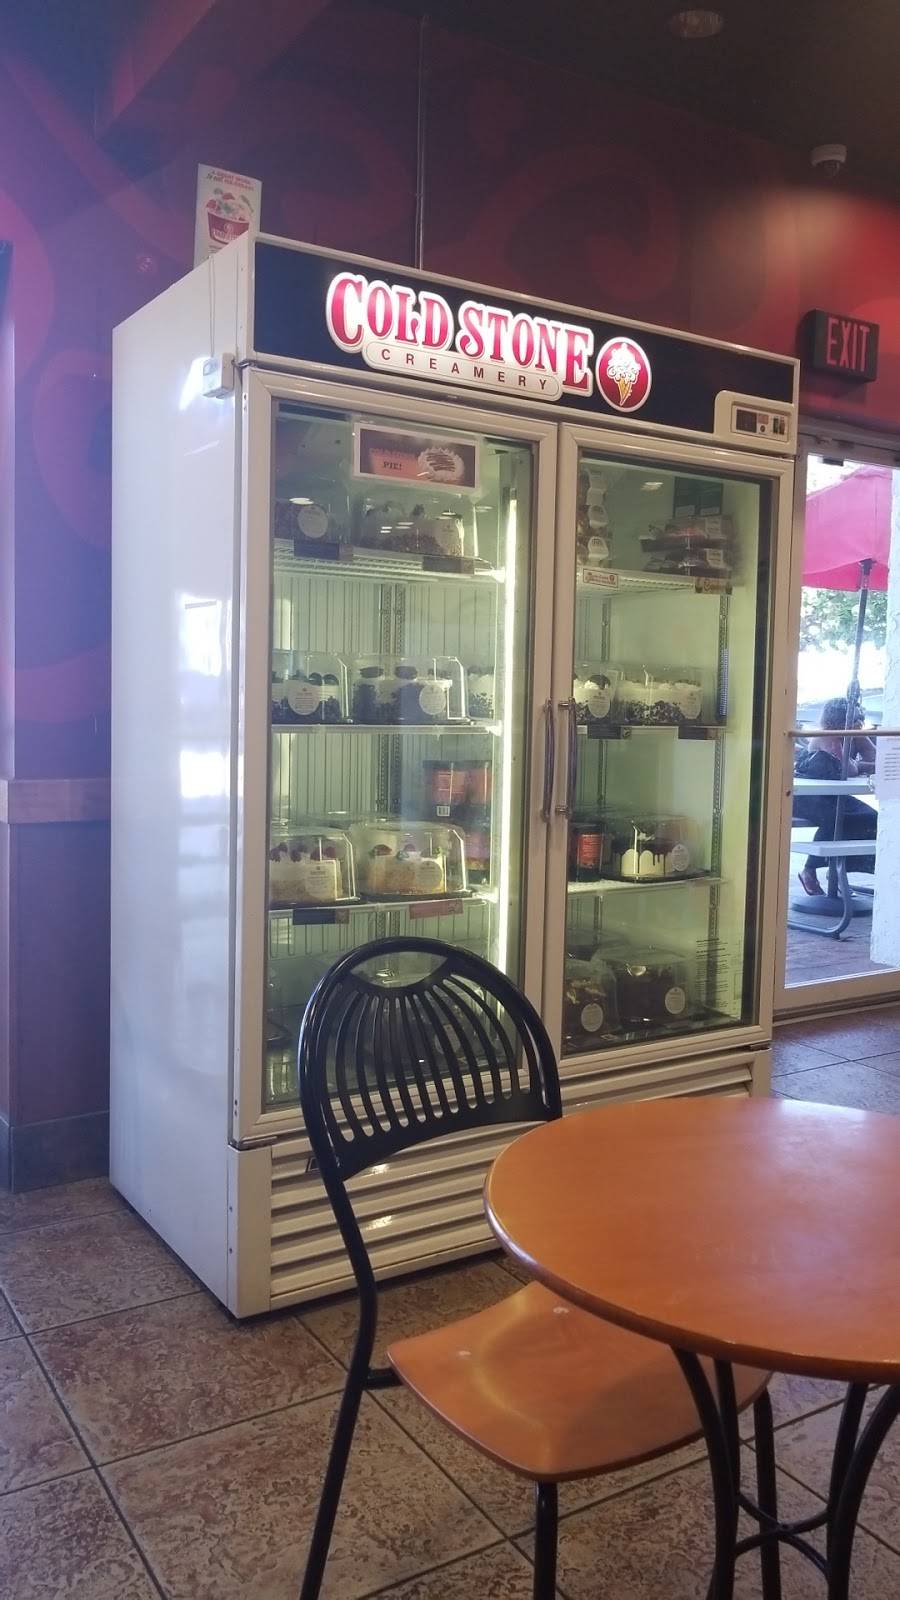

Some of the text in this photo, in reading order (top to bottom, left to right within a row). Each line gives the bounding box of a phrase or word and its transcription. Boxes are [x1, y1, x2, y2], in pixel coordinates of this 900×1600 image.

[329, 274, 591, 393] COLD STONE
[826, 317, 870, 371] EXIT
[381, 347, 549, 391] CREAMERY
